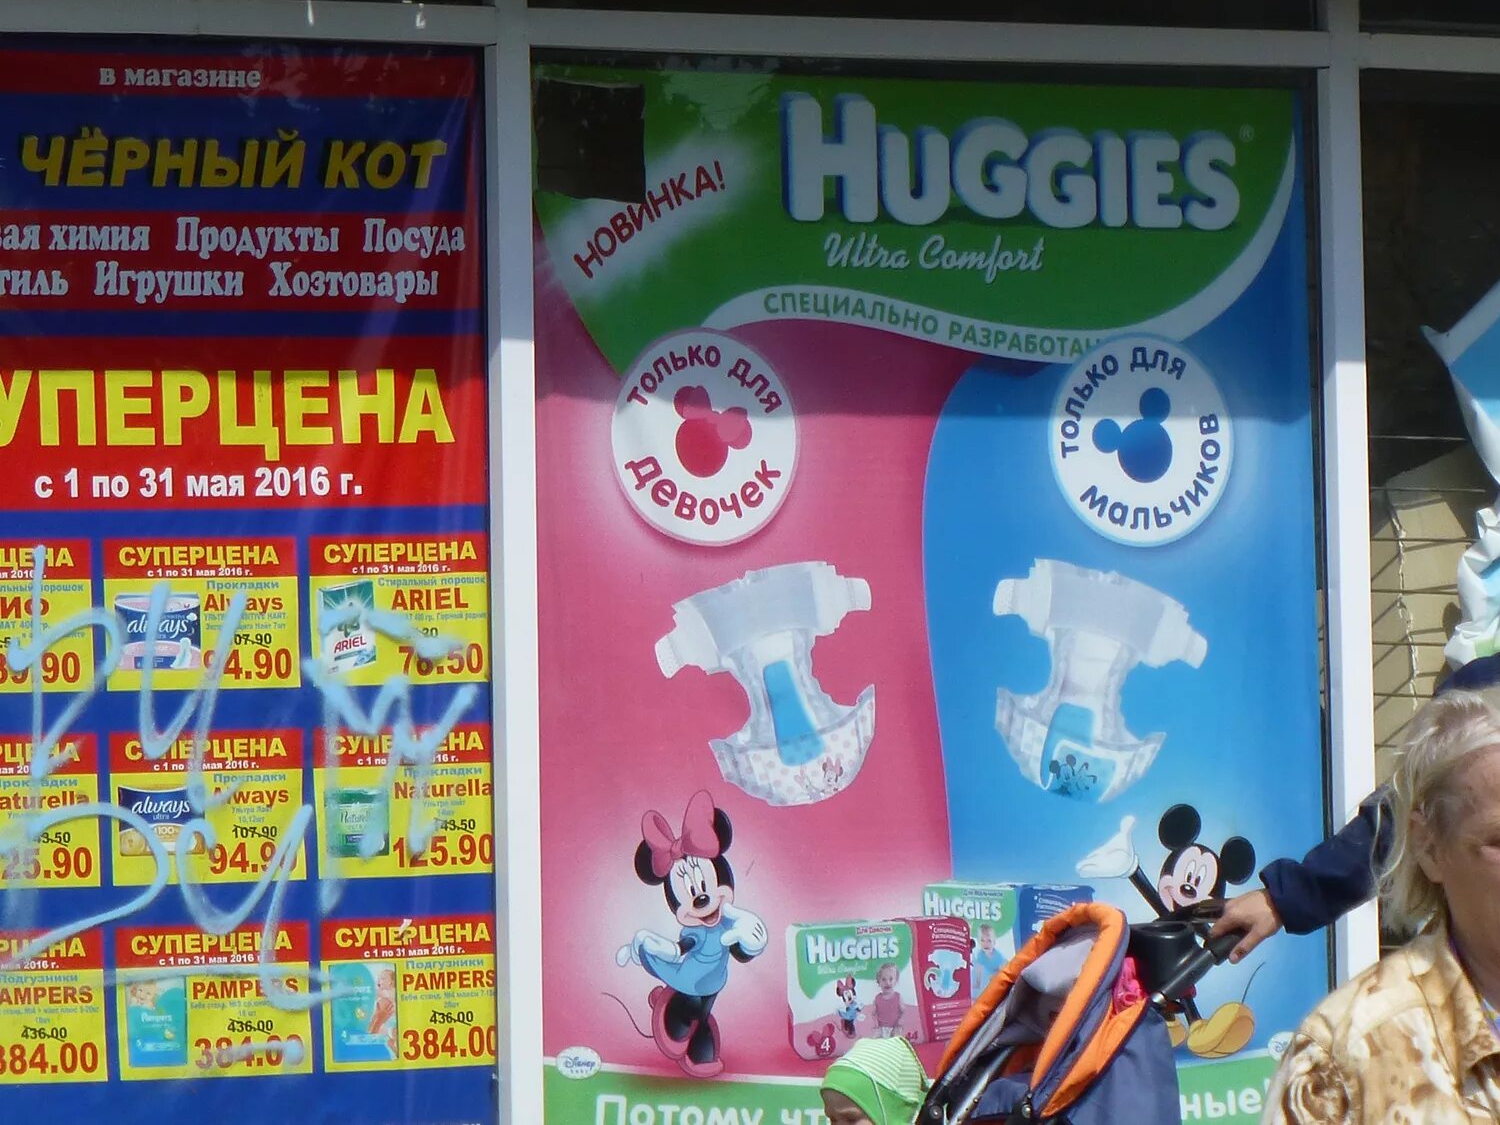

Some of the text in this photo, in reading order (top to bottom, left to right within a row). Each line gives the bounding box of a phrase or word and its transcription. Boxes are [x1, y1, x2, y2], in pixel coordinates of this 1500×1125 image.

[99, 68, 261, 89] в магазине
[21, 126, 448, 189] ЧЁРНЫЙ КОТ
[781, 90, 1241, 231] HUGGIES
[573, 160, 725, 279] НОВИНКА!
[48, 225, 150, 251] химия
[175, 216, 340, 259] Продукты
[362, 219, 466, 258] Посуда
[824, 233, 1047, 283] Ultra Comfort
[94, 261, 244, 304] Игрушки
[268, 262, 439, 304] Хозтовары
[763, 292, 939, 335] СПЕЦИАЛЬНО
[35, 467, 362, 498] с 1 по 31 мая 2016 г.
[118, 546, 279, 567] СУПЕРЦЕНА
[324, 541, 477, 563] СУПЕРЦЕНА
[181, 568, 193, 576] 31
[218, 567, 242, 576] 2016
[367, 566, 379, 574] по
[382, 565, 394, 573] 31
[397, 565, 415, 573] мая
[417, 564, 439, 573] 2016
[206, 580, 279, 591] Прокладки
[391, 588, 468, 610] ARIEL
[334, 636, 367, 653] ARIEL
[226, 760, 249, 769] 2016
[132, 796, 190, 819] always
[923, 891, 1002, 921] HUGGIES
[335, 922, 491, 948] СУПЕРЦЕНА
[194, 956, 205, 964] 31
[230, 954, 254, 963] 2016
[382, 949, 394, 957] по
[396, 947, 405, 957] 31
[409, 948, 429, 956] мая
[432, 946, 455, 955] 2016
[806, 933, 900, 964] HUGGIES
[406, 959, 483, 970] Подгузники
[402, 970, 495, 992] PAMPERS
[228, 1019, 273, 1034] 436.00
[430, 1011, 473, 1025] 436.00
[21, 1026, 67, 1041] 436.00
[821, 1036, 830, 1052] 4
